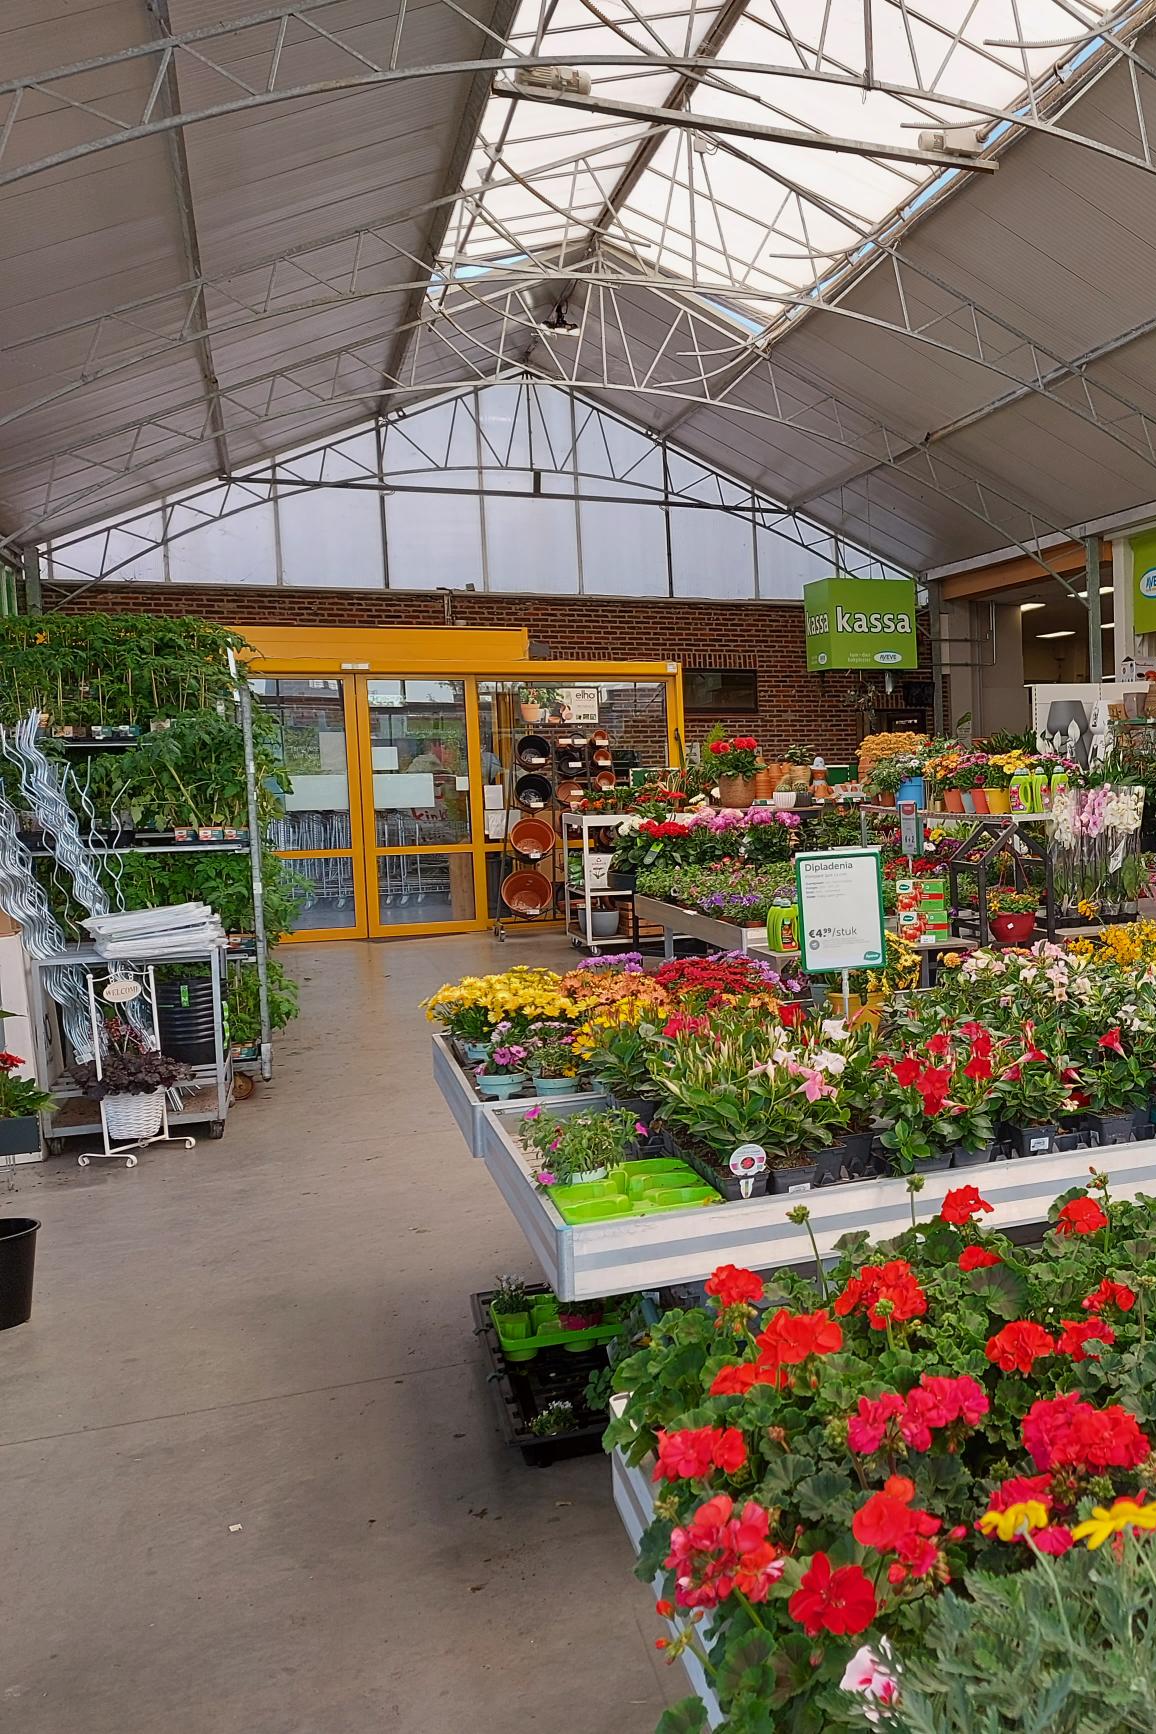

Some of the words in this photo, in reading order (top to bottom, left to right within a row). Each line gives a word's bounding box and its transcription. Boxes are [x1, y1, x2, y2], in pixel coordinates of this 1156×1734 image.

[806, 610, 829, 636] kassa
[836, 606, 912, 633] kassa
[575, 690, 596, 699] elho
[804, 862, 854, 873] Dipladenia
